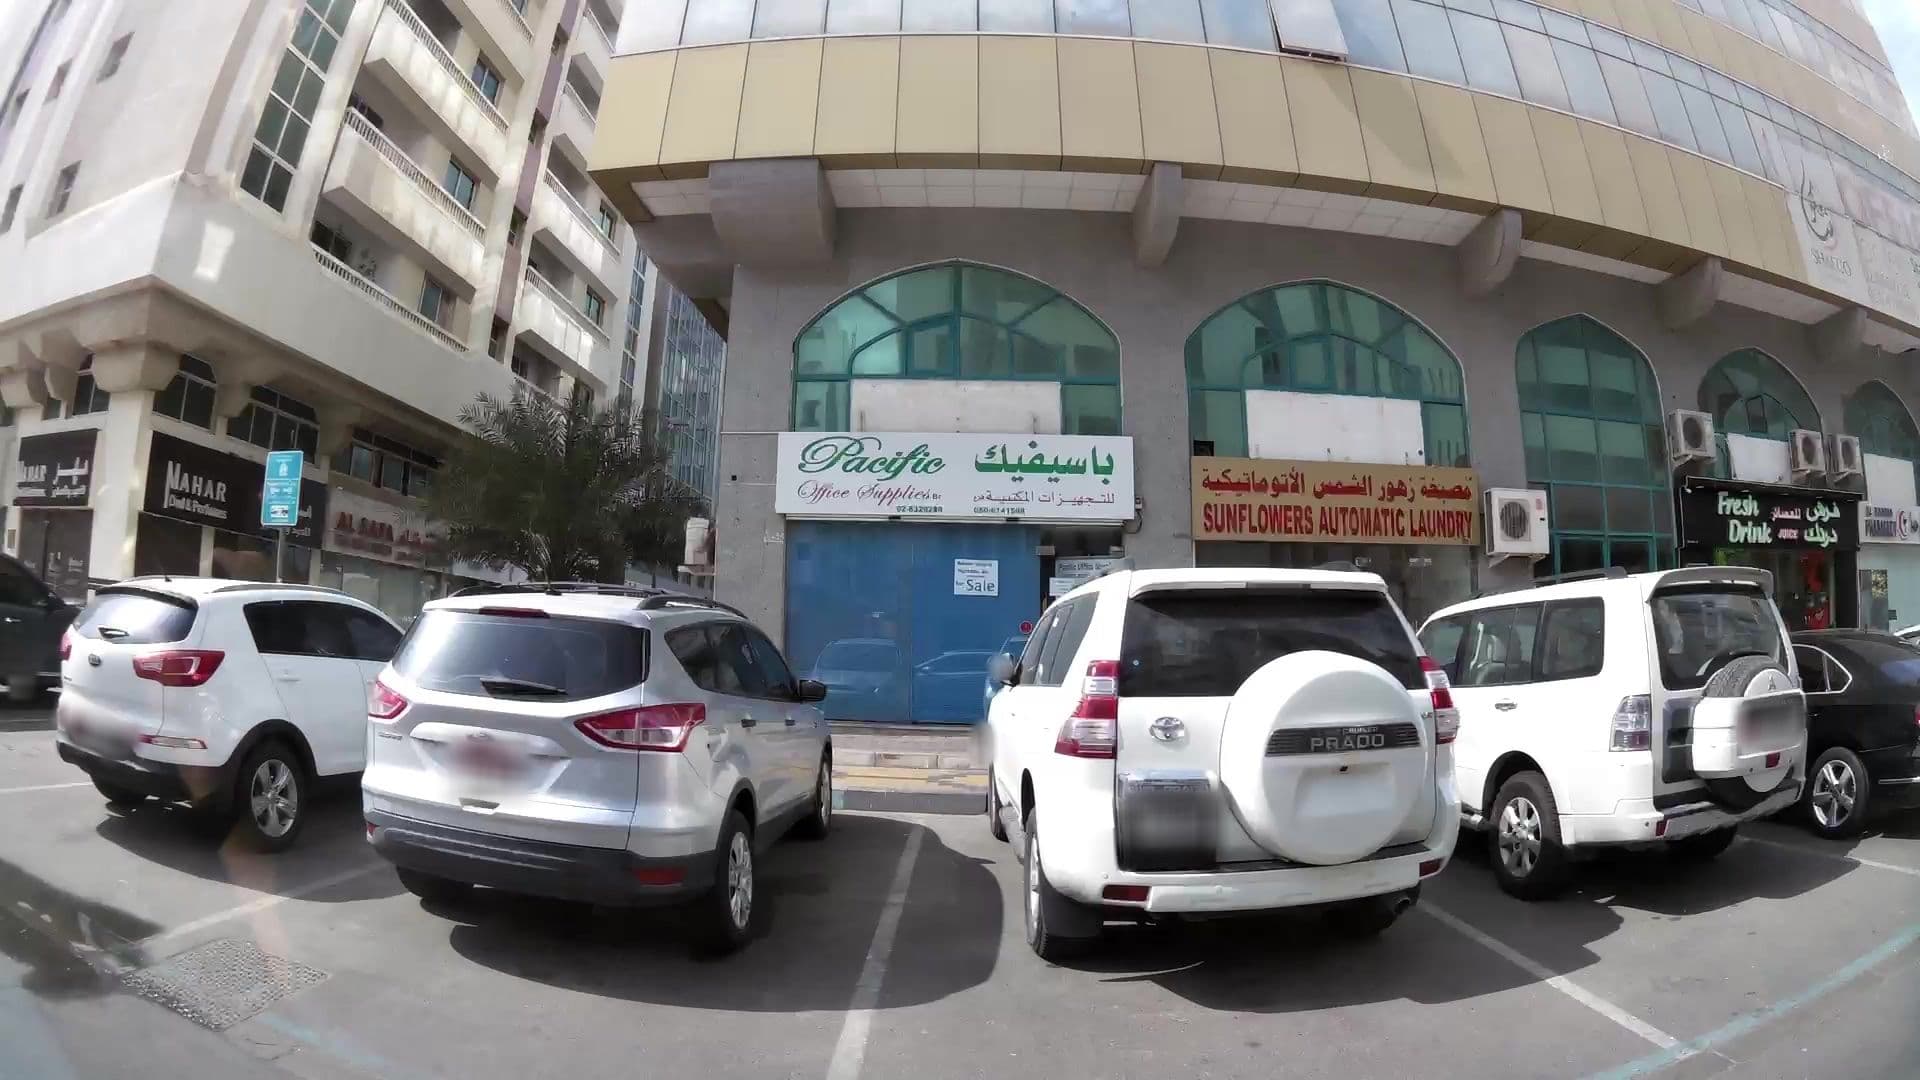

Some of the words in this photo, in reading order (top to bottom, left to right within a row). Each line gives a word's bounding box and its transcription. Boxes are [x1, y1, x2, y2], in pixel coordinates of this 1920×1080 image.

[797, 436, 946, 482] Pacific
[974, 440, 1115, 485] باسيفيك
[163, 460, 227, 508] MAHAR
[797, 479, 851, 505] Office
[856, 482, 931, 506] Supplies
[1313, 474, 1373, 499] الشمس
[1377, 477, 1416, 503] زهور
[1717, 491, 1760, 517] Fresh
[1203, 502, 1315, 534] SUNFLOWERS
[1319, 505, 1406, 537] AUTOMATIC
[1409, 508, 1473, 538] LAUNDRY
[1727, 519, 1773, 544] Drink
[966, 579, 996, 592] Sale
[1310, 733, 1385, 752] PRADO
